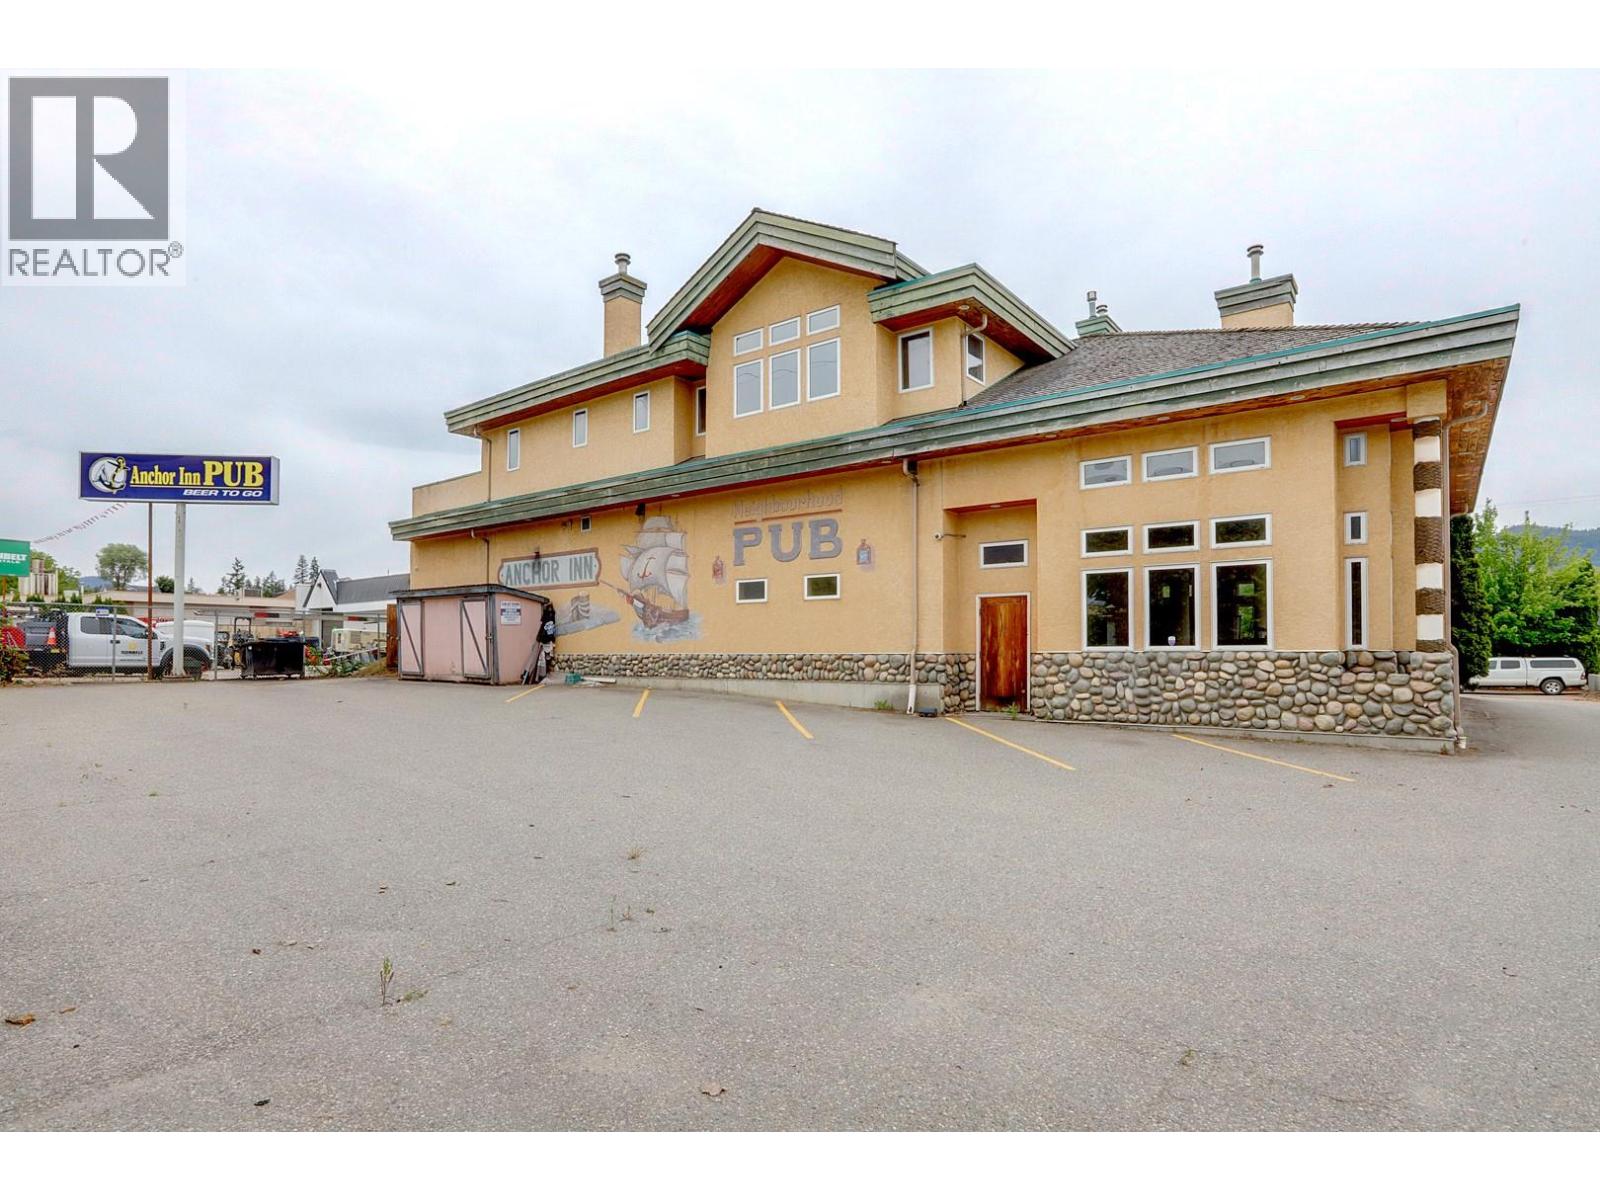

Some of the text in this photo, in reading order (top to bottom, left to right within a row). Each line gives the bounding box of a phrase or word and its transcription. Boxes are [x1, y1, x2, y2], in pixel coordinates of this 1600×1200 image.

[130, 460, 264, 487] Anchor Inn PUB
[183, 489, 218, 497] BEER
[242, 490, 263, 498] GO
[733, 518, 843, 567] PUB
[505, 555, 593, 585] ANCHOR INN
